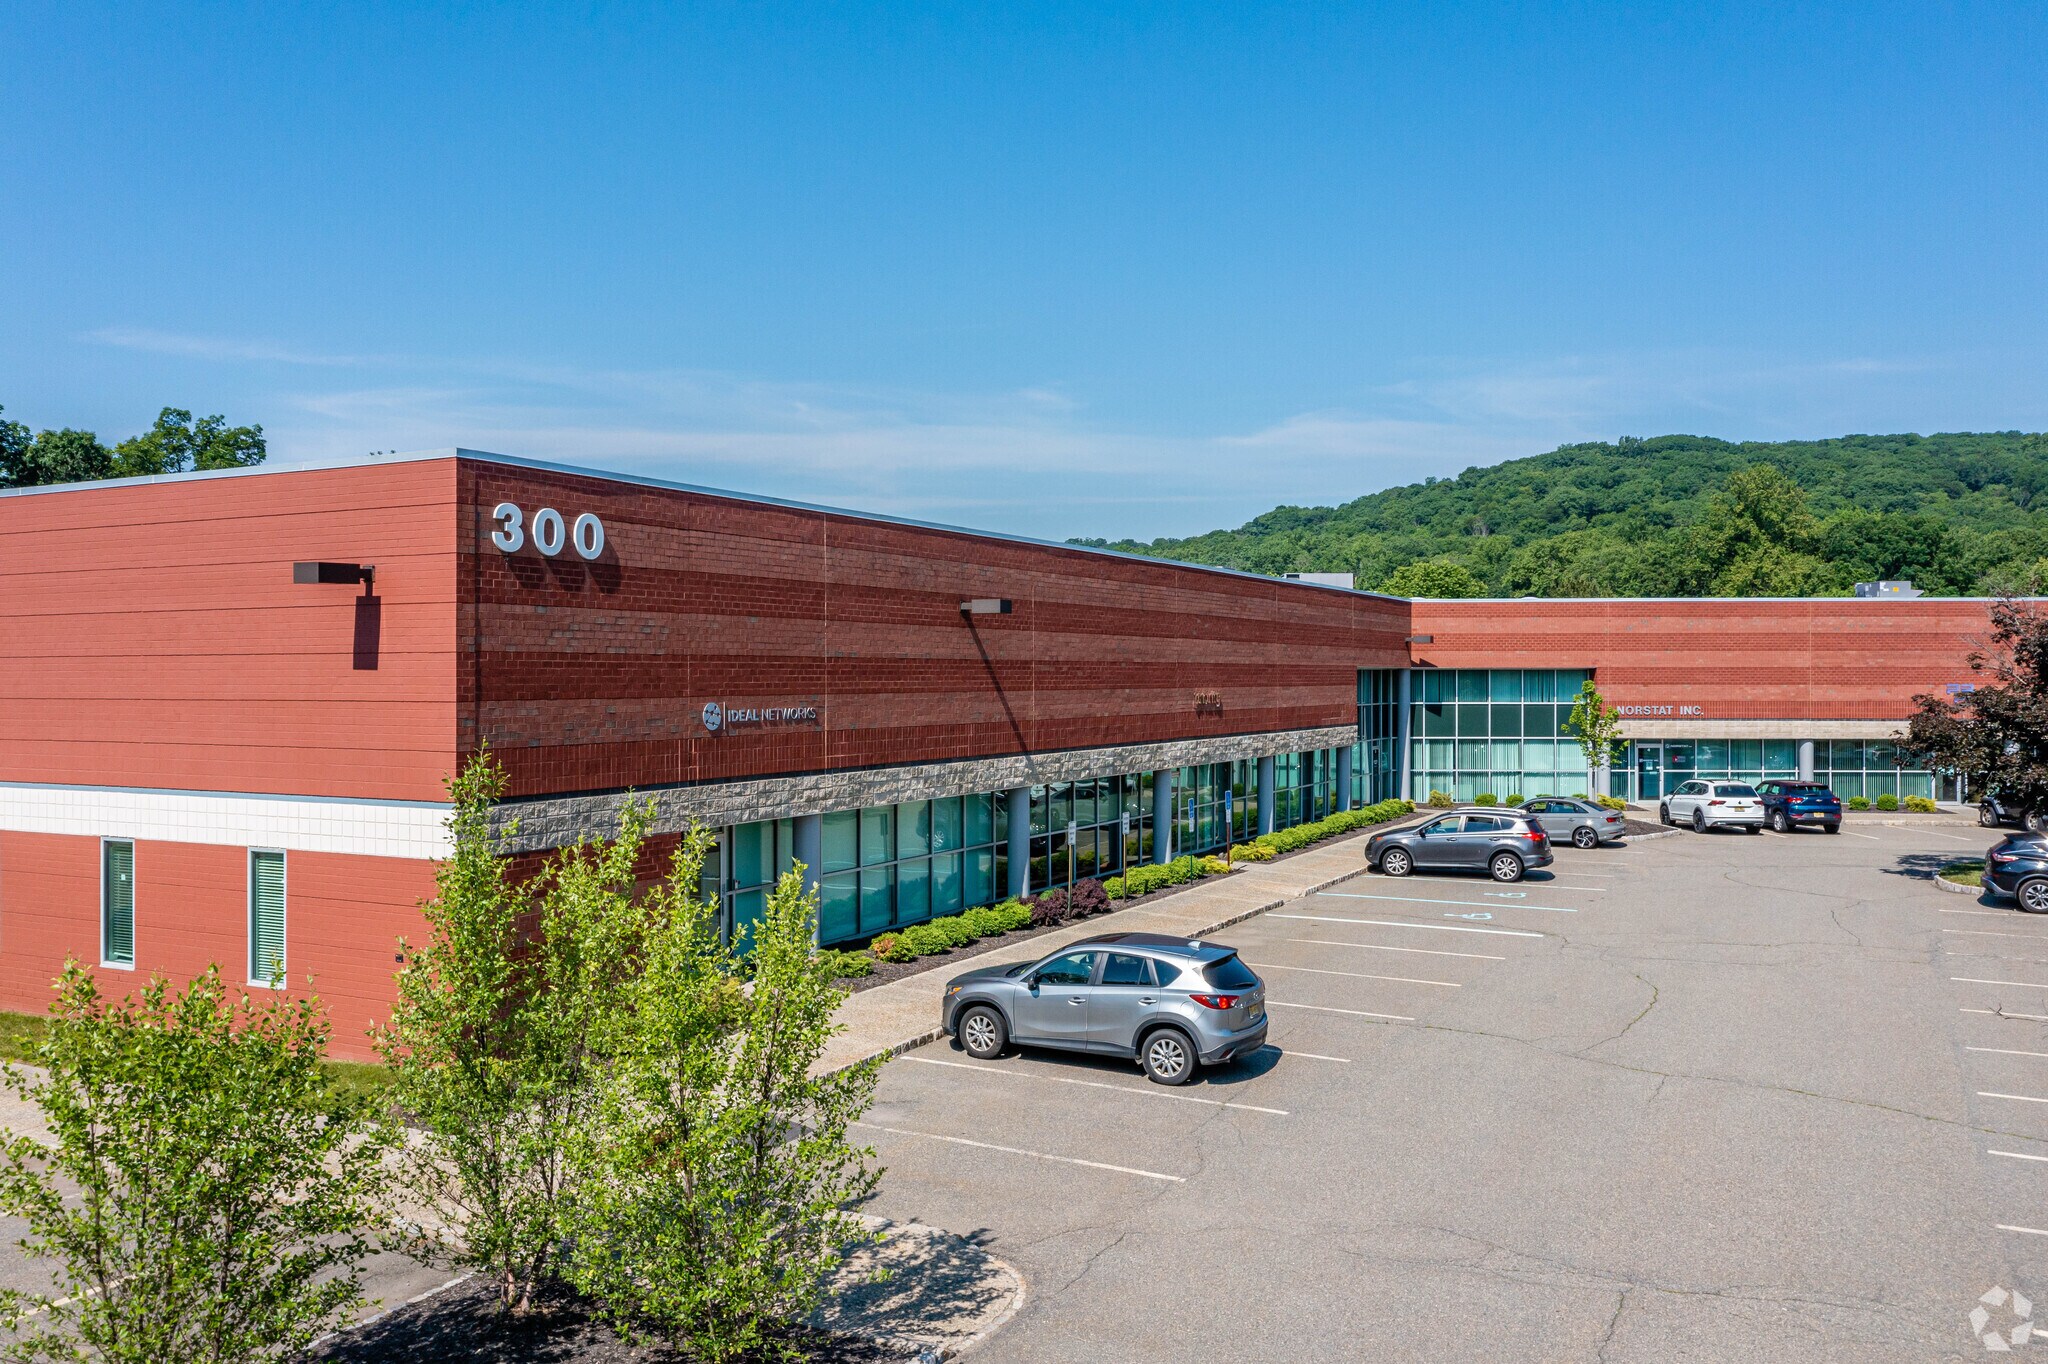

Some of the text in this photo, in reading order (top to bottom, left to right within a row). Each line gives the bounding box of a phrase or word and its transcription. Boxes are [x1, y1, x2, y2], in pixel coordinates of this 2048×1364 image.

[491, 502, 605, 560] 300
[727, 706, 817, 722] IDEAL NETWORKS
[1616, 705, 1705, 716] NORSTAT INC.
